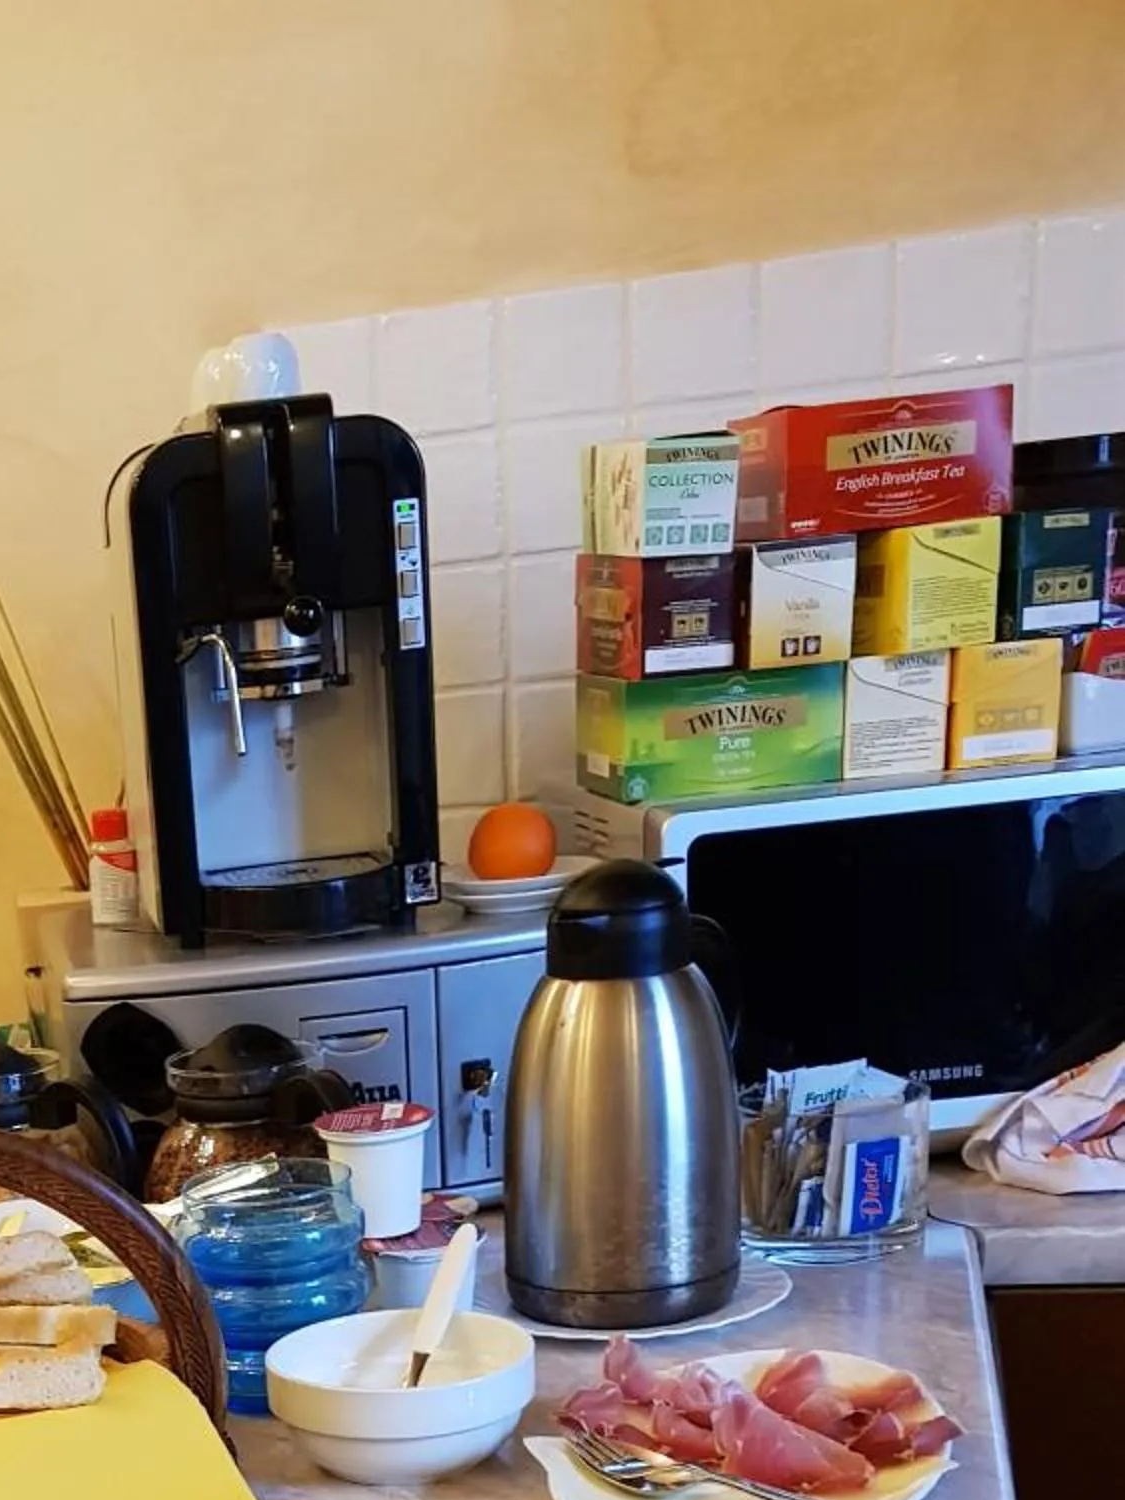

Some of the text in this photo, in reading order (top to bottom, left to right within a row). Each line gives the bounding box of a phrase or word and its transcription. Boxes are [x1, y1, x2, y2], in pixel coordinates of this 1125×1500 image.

[848, 430, 955, 465] TWININGS
[648, 472, 734, 488] COLLECTION
[836, 463, 967, 493] English Breakfast Tea
[684, 703, 787, 735] TWININGS
[718, 735, 752, 750] Pure
[908, 1063, 984, 1081] SAMSUNG
[352, 1082, 402, 1104] AZZA
[804, 1085, 850, 1106] Frutti
